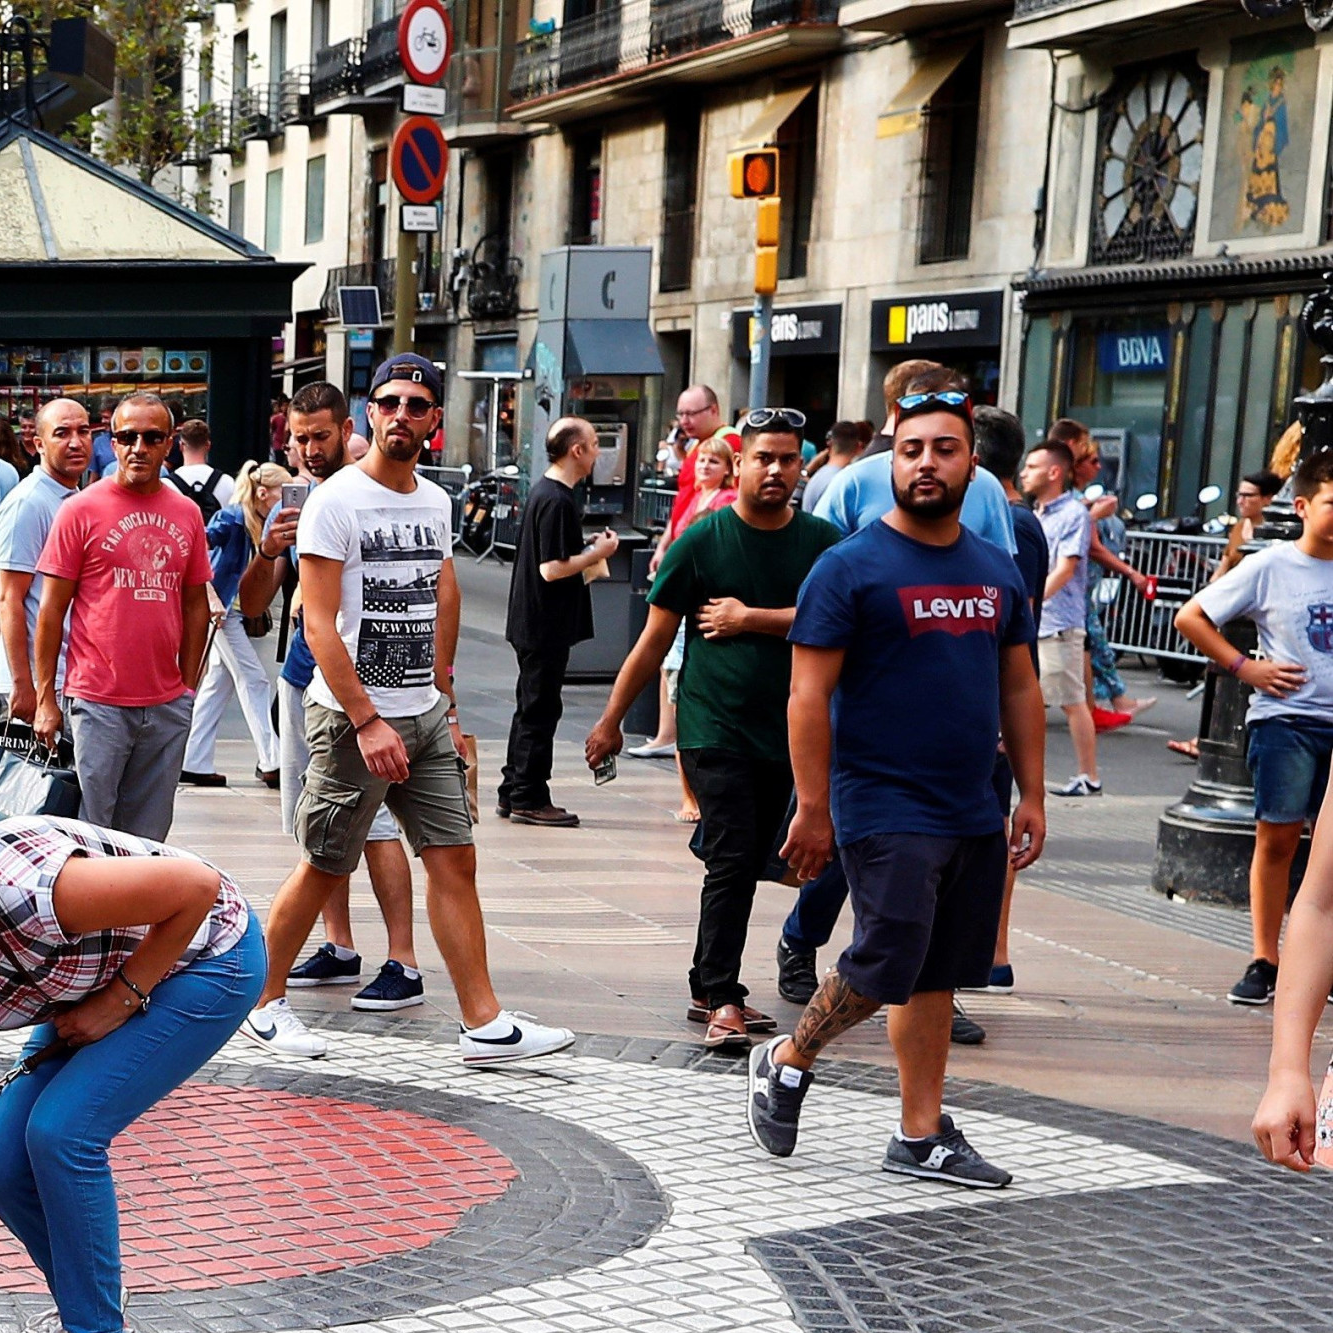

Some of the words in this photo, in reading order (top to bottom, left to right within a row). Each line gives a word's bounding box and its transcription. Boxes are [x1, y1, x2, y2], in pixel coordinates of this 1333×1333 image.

[771, 313, 798, 342] ans
[907, 302, 949, 343] pans
[1117, 336, 1164, 366] BBVA
[101, 528, 123, 552] FAR
[118, 511, 167, 533] ROCKAWAY
[167, 522, 190, 558] BEACH
[113, 567, 136, 588] NEW
[140, 570, 162, 588] YORK
[371, 621, 403, 633] NEW
[404, 622, 432, 634] YORK
